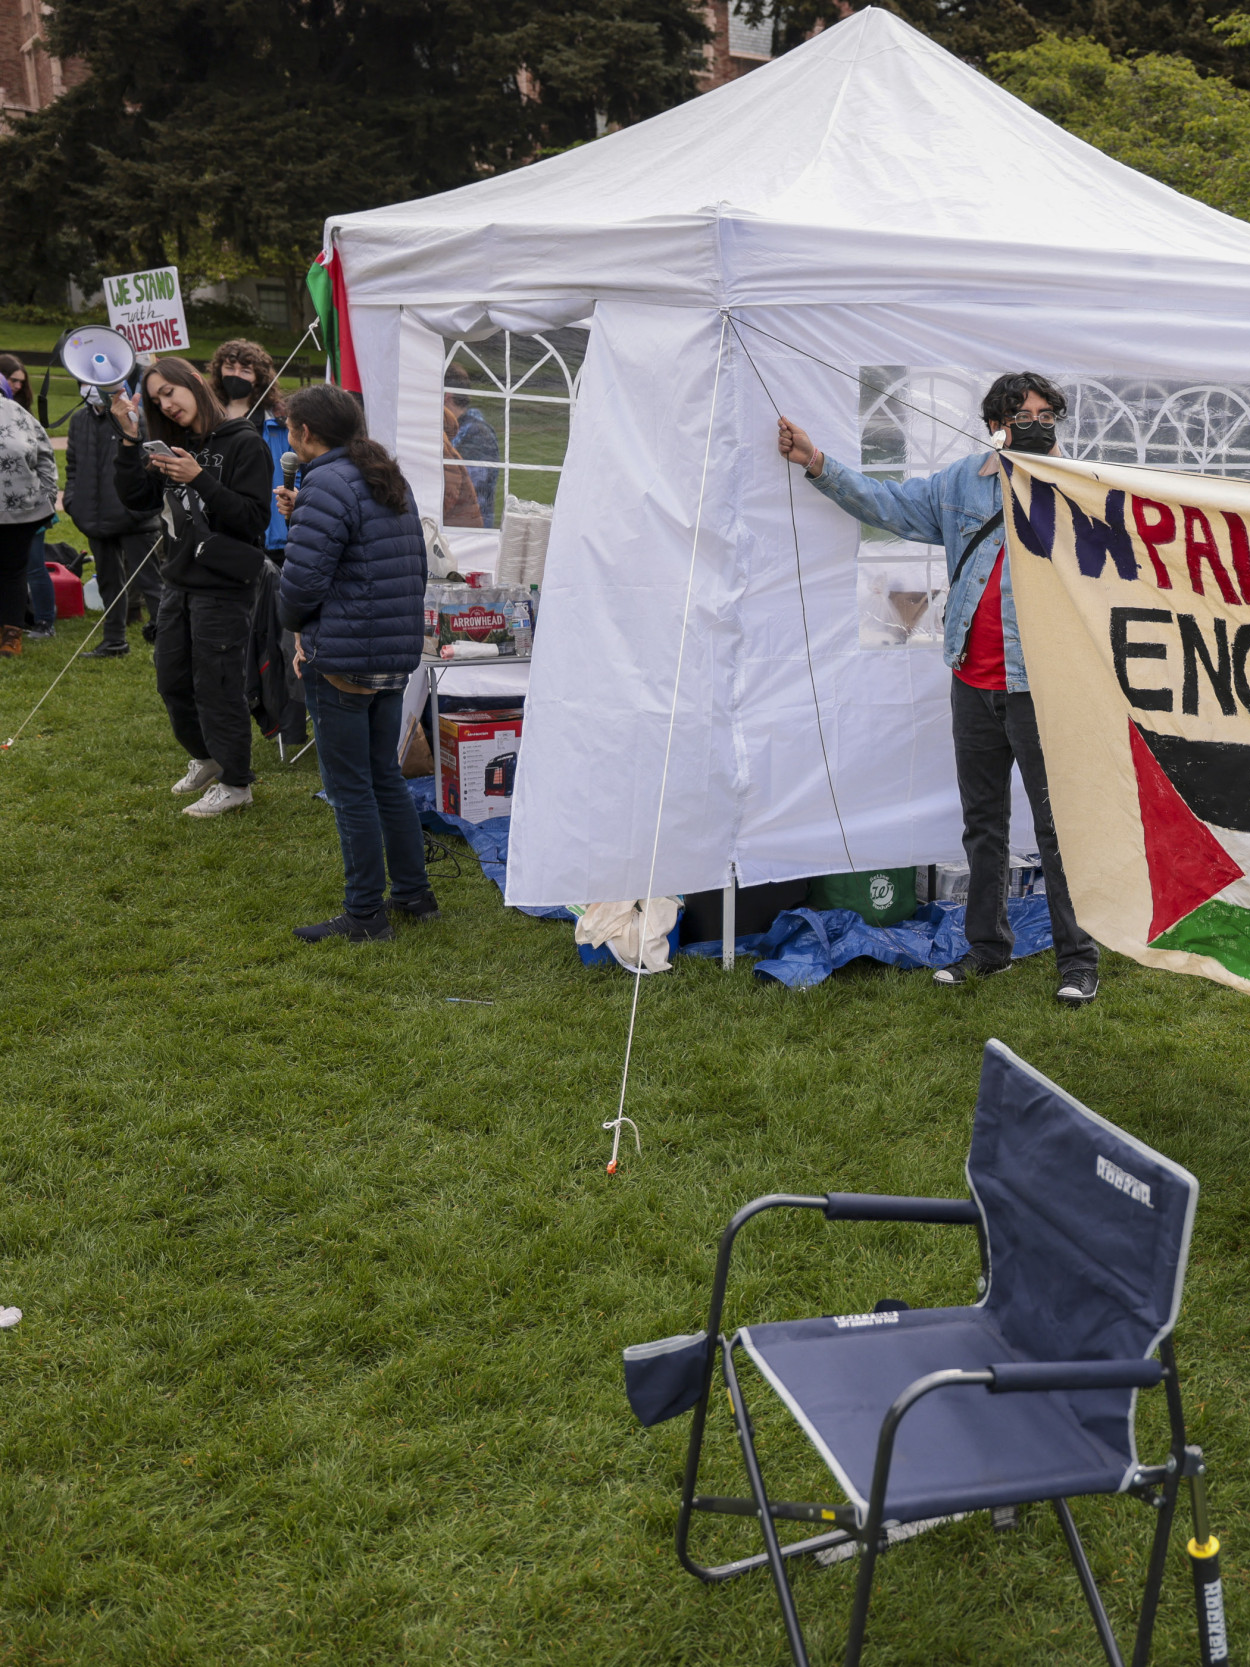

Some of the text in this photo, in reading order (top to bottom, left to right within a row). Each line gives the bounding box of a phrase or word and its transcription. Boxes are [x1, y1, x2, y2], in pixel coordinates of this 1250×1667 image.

[109, 271, 175, 307] WE STAND
[121, 304, 164, 323] with
[1000, 456, 1141, 581] UW
[453, 615, 503, 628] ARROWHEAD
